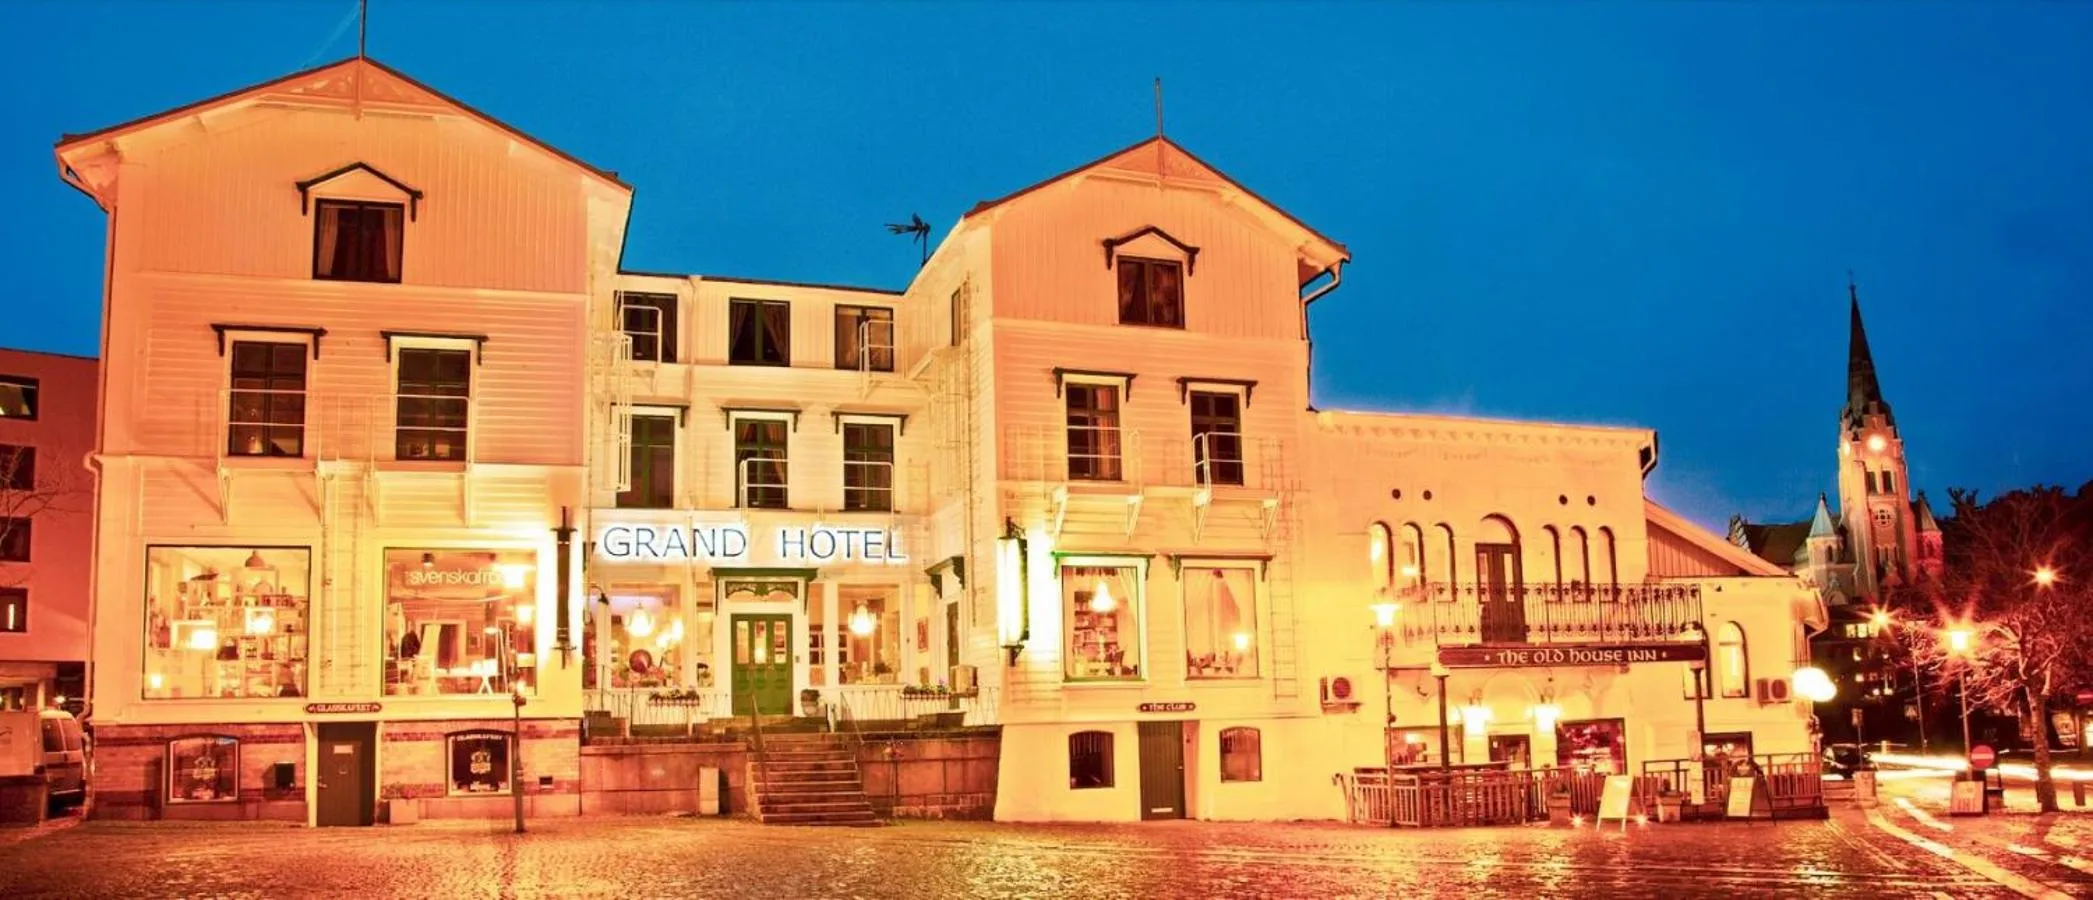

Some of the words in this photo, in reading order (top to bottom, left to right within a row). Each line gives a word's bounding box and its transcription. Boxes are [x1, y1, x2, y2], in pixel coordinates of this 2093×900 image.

[603, 526, 747, 559] GRAND
[781, 528, 907, 560] HOTEL
[1627, 649, 1657, 662] INN
